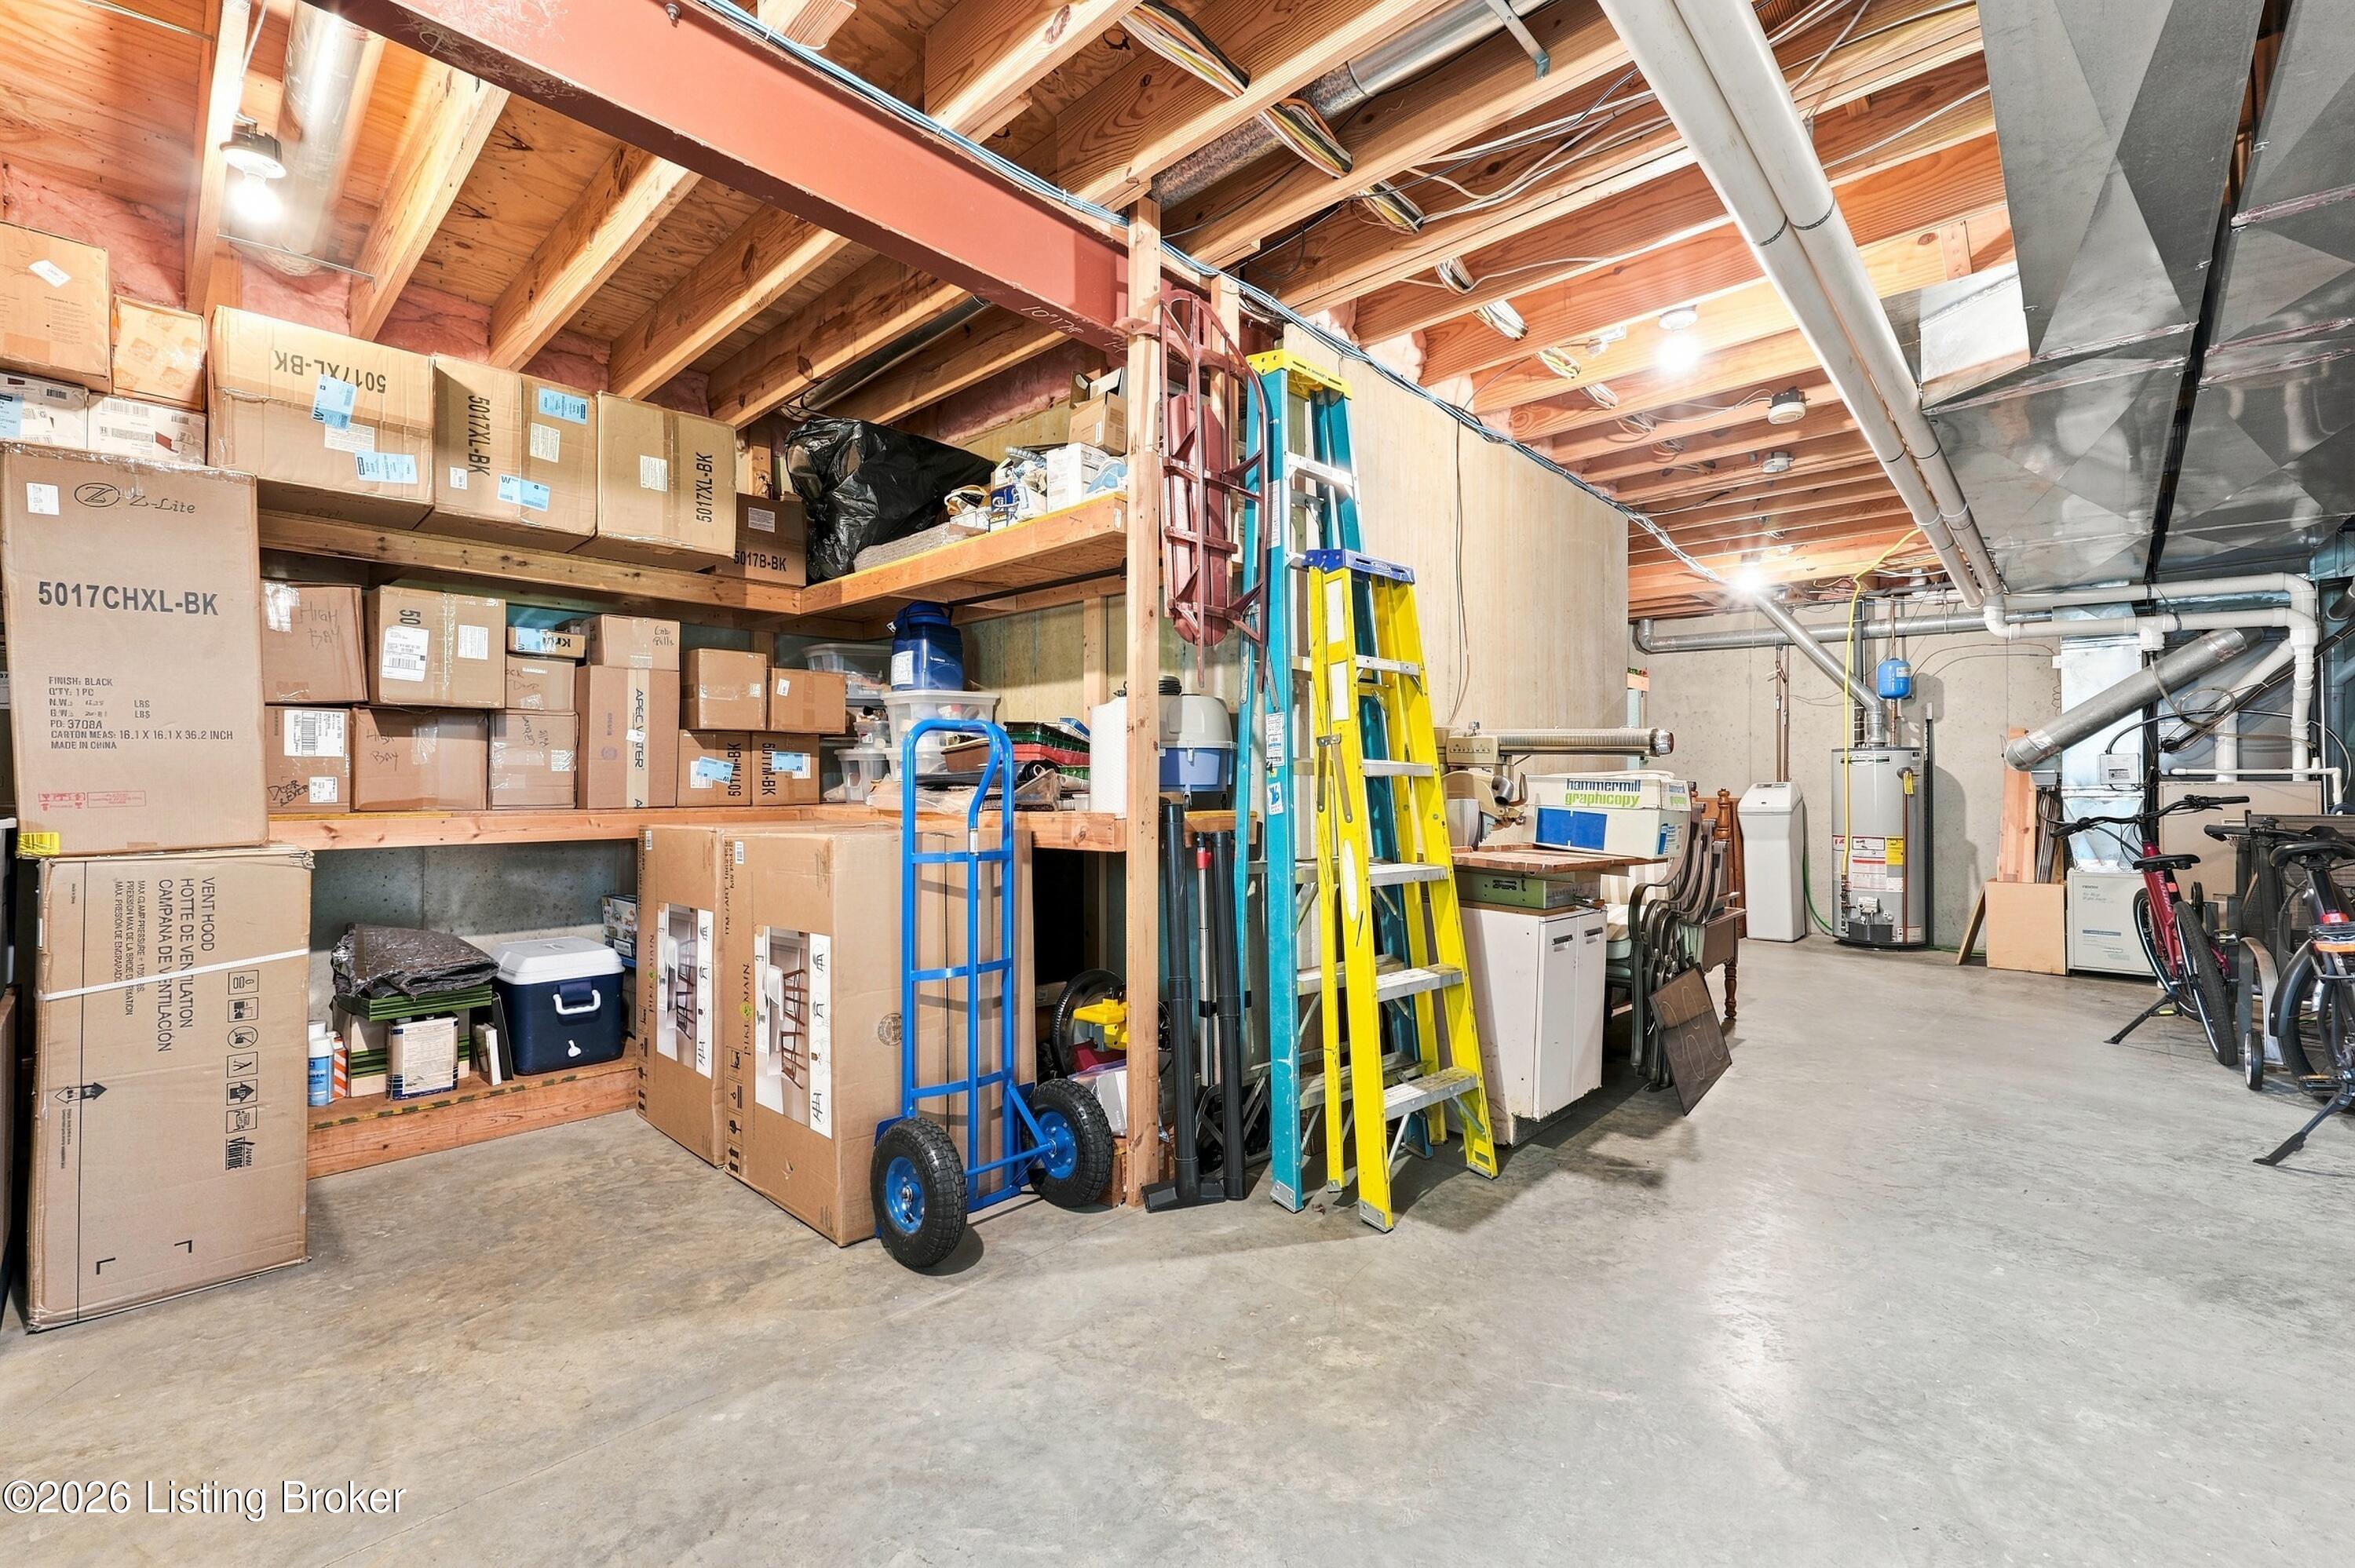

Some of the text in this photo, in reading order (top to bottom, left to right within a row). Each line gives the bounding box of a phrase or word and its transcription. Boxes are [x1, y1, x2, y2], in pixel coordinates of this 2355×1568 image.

[274, 350, 386, 394] 5017XL-BK
[468, 395, 491, 477] 5017XL-BK
[696, 452, 714, 523] 5017XL-BK
[130, 494, 196, 515] Z-Lite
[734, 550, 787, 572] 5017B-BK
[38, 581, 219, 616] 5017CHXL-BK
[49, 676, 113, 686] FINISH: BLACK
[49, 687, 72, 696] Q'TY:
[635, 688, 644, 723] APEC
[50, 720, 103, 729] PO: 3708A
[51, 731, 233, 740] CARTON MEAS: 16.1 X 16.1 X 36.2 INCH
[51, 741, 76, 749] MADE
[78, 741, 89, 749] IN
[728, 742, 742, 797] 5017M-BK
[761, 743, 776, 796] 5017M-BK
[1567, 779, 1641, 792] hammermill
[1565, 793, 1640, 808] graphicopy
[126, 881, 134, 915] PRESSION
[180, 878, 195, 921] HOTTE
[158, 879, 173, 943] CAMPANA
[200, 877, 216, 952] VENT HOOD
[126, 916, 134, 931] MAX
[180, 924, 195, 943] DE
[115, 931, 122, 940] DE
[126, 932, 134, 942] DE
[137, 920, 145, 956] PRESSURE
[126, 943, 134, 952] LA
[158, 946, 173, 965] DE
[126, 953, 134, 973] BRIDE
[125, 986, 133, 1016] FIXATION
[236, 1087, 246, 1097] UP
